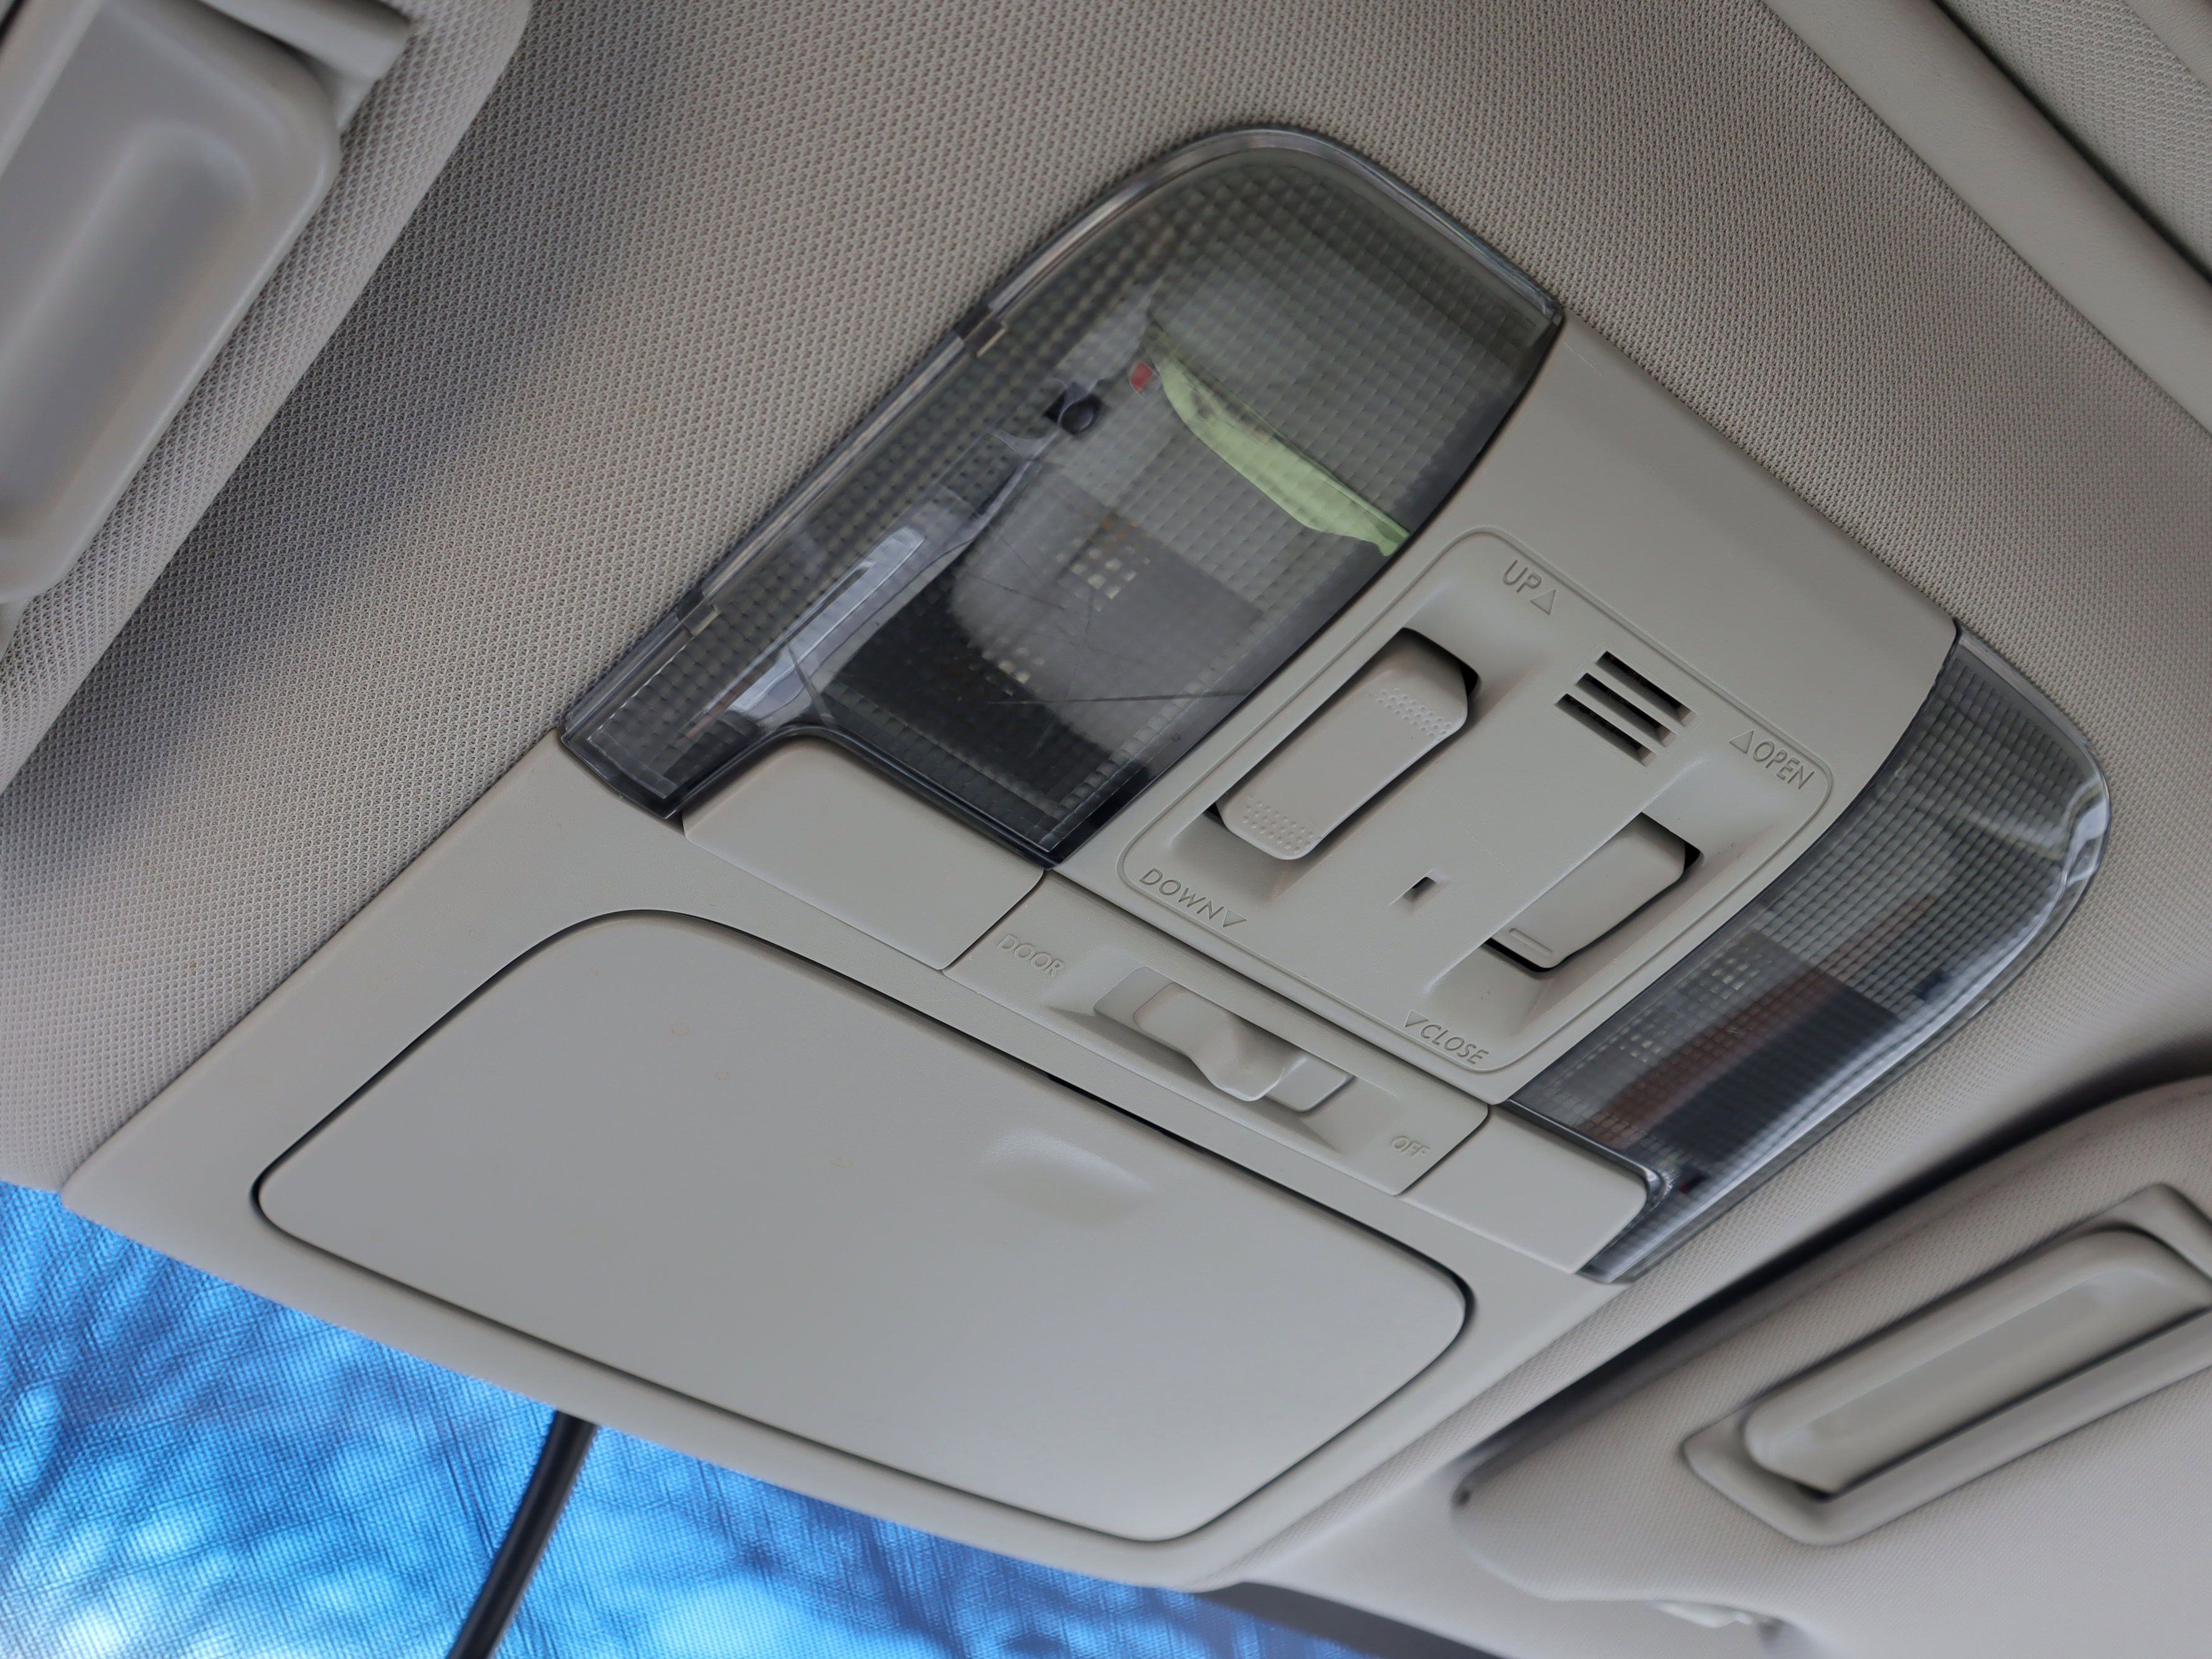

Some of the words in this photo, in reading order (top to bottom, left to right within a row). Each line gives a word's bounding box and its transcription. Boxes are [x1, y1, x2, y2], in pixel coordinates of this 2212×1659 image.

[1503, 560, 1542, 593] UP
[1752, 740, 1815, 790] OPEN
[1139, 867, 1224, 919] DOWN
[996, 933, 1064, 977] DOOR
[1420, 1024, 1490, 1064] CLOSE
[1390, 1135, 1430, 1159] OFF
